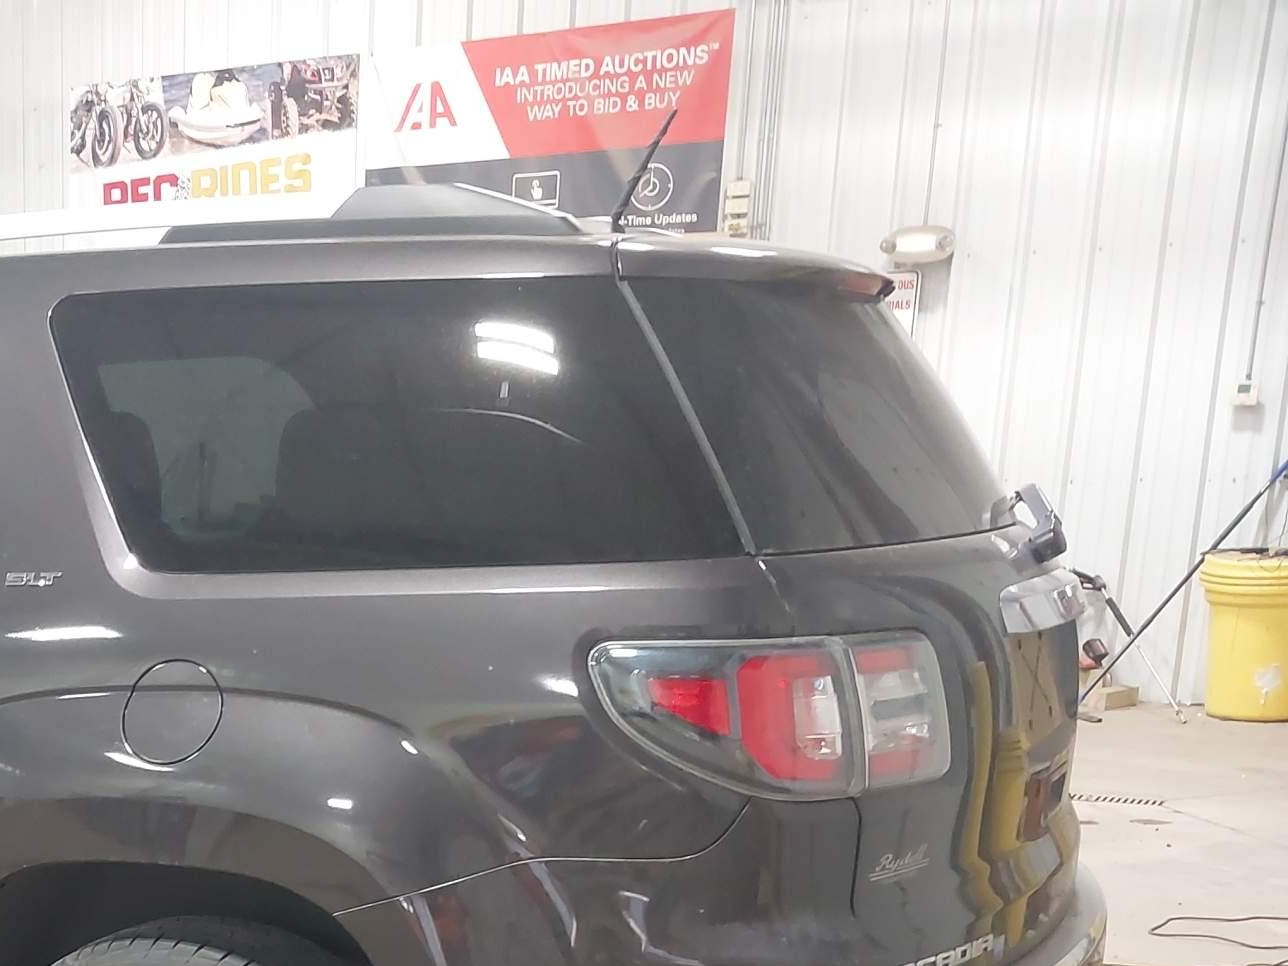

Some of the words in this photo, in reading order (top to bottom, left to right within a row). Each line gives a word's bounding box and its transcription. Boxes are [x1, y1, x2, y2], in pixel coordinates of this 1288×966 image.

[495, 65, 530, 87] IAA
[534, 57, 594, 81] TIMED
[516, 76, 629, 104] INTRODUCING
[634, 75, 648, 91] A
[652, 69, 695, 89] NEW
[527, 102, 562, 122] WAY
[567, 99, 589, 117] TO
[593, 97, 622, 115] BID
[625, 95, 639, 112] &
[644, 90, 681, 112] BUY
[654, 212, 698, 226] Updates
[5, 571, 63, 587] SLT
